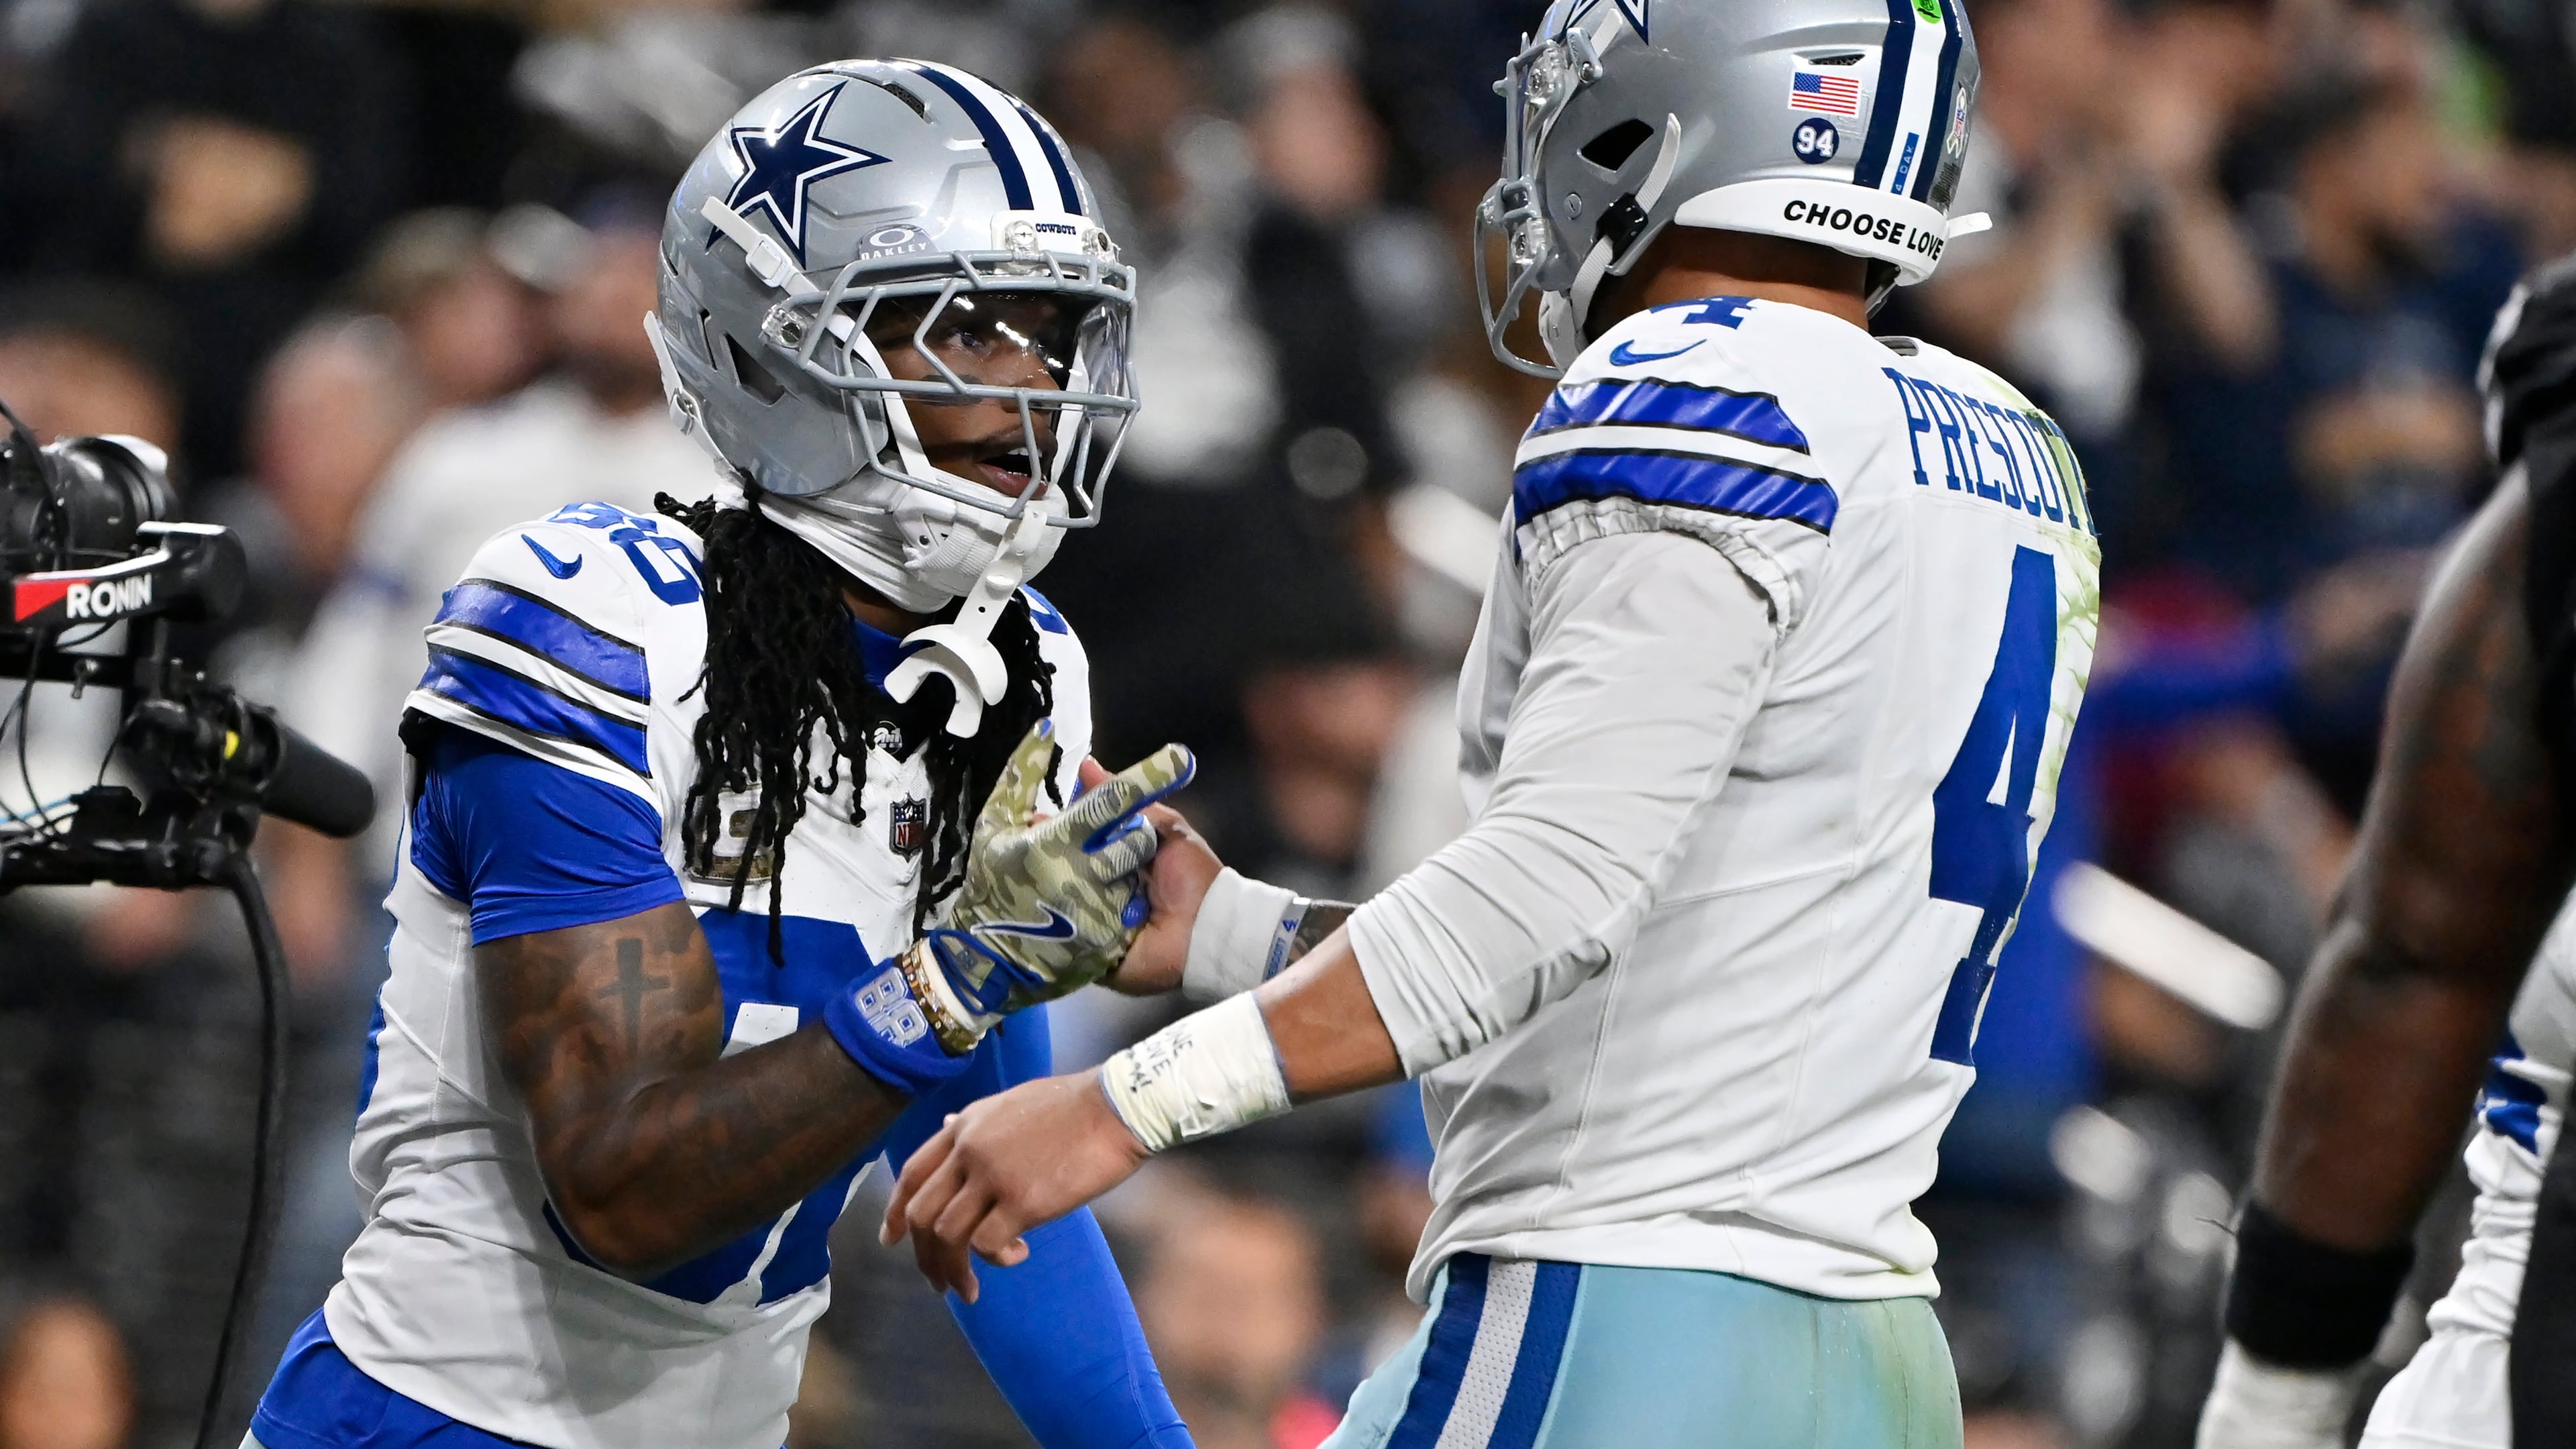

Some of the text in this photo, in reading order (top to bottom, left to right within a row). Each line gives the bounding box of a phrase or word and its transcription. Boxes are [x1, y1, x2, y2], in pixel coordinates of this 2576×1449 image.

[1796, 125, 1834, 158] 94
[1898, 145, 1915, 174] DAK
[1035, 223, 1077, 235] COWBOYS
[1784, 200, 1944, 261] CHOOSE LOVE
[861, 241, 928, 260] OAKLEY
[1880, 367, 2097, 536] PRESCOTT
[66, 572, 153, 619] RONIN
[1929, 544, 2057, 1066] 4
[1142, 1039, 1171, 1077] OVE
